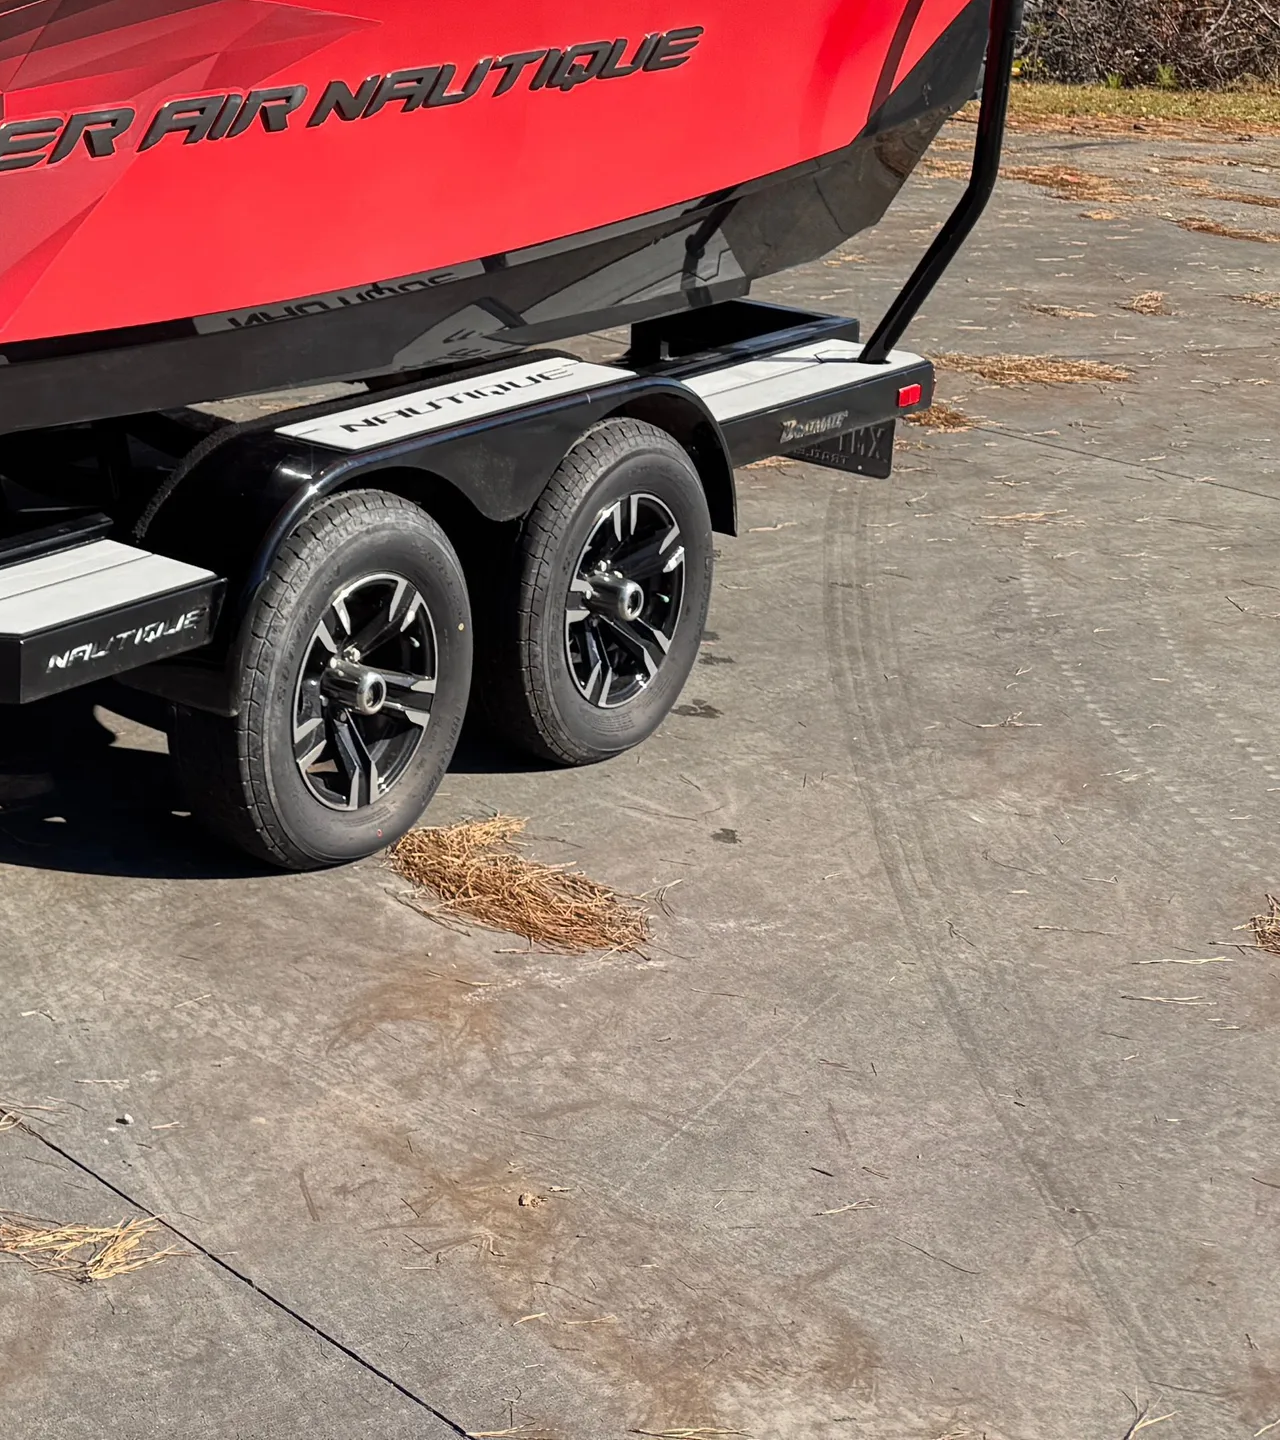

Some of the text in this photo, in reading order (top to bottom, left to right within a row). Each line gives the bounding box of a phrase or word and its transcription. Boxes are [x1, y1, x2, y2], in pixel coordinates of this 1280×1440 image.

[137, 84, 307, 153] AIR
[306, 26, 704, 128] NAUTIQUE
[339, 367, 575, 433] NAUTIQUE
[46, 609, 202, 674] NAUTIQUE
